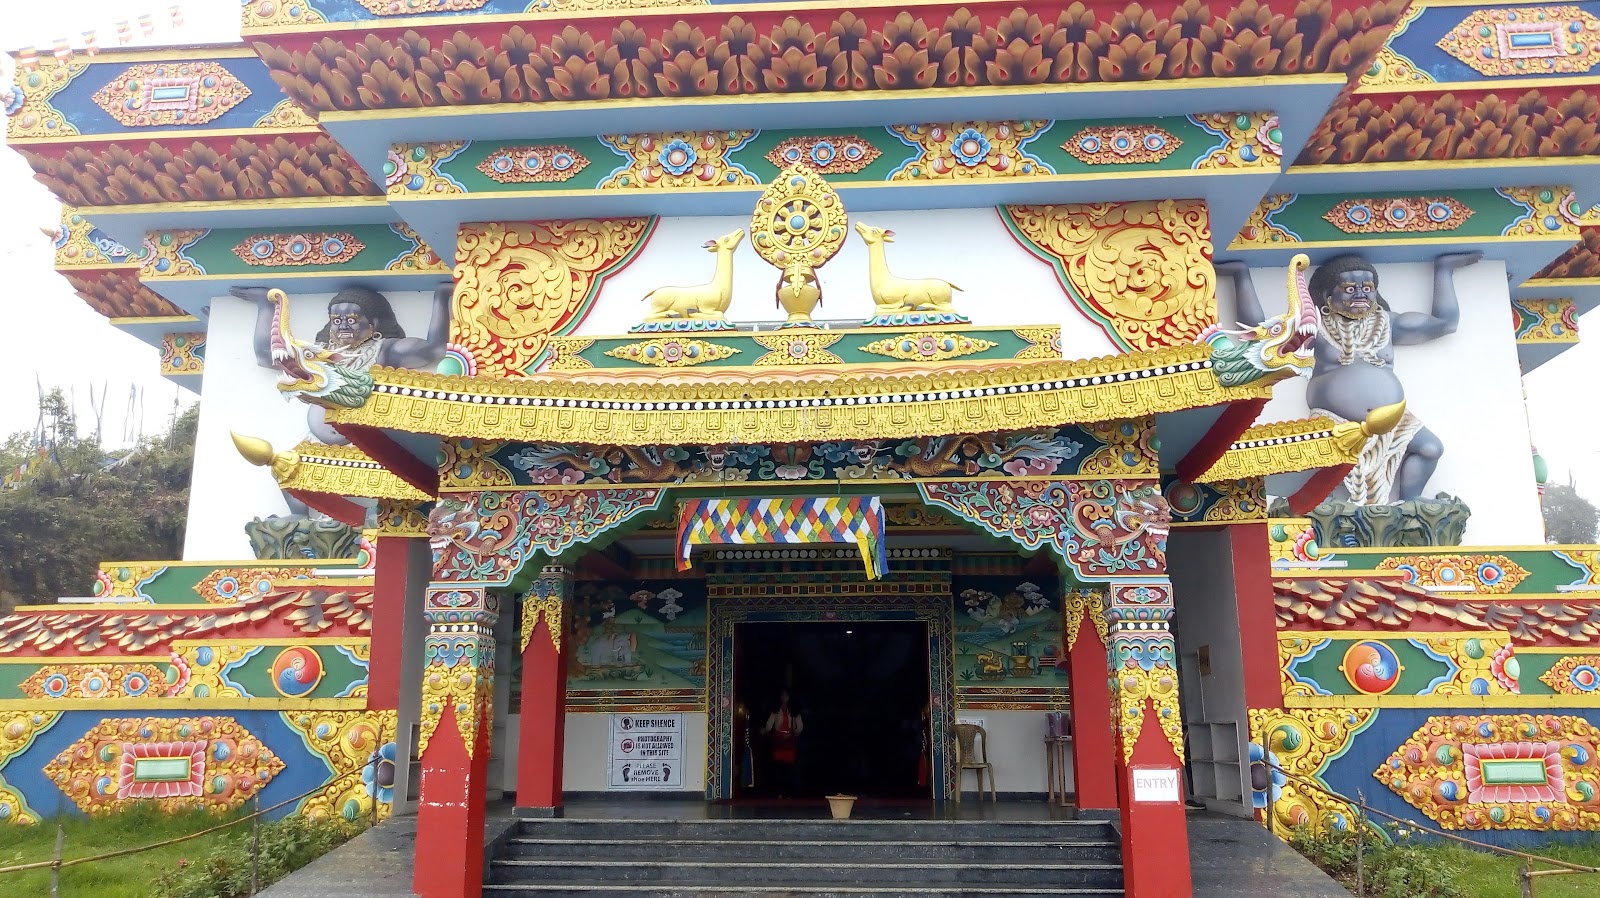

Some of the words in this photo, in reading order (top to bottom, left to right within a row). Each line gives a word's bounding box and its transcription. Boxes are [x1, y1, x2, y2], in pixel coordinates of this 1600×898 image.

[635, 719, 650, 728] KEEP
[651, 719, 675, 728] SILENCE
[1136, 776, 1175, 789] ENTRY
